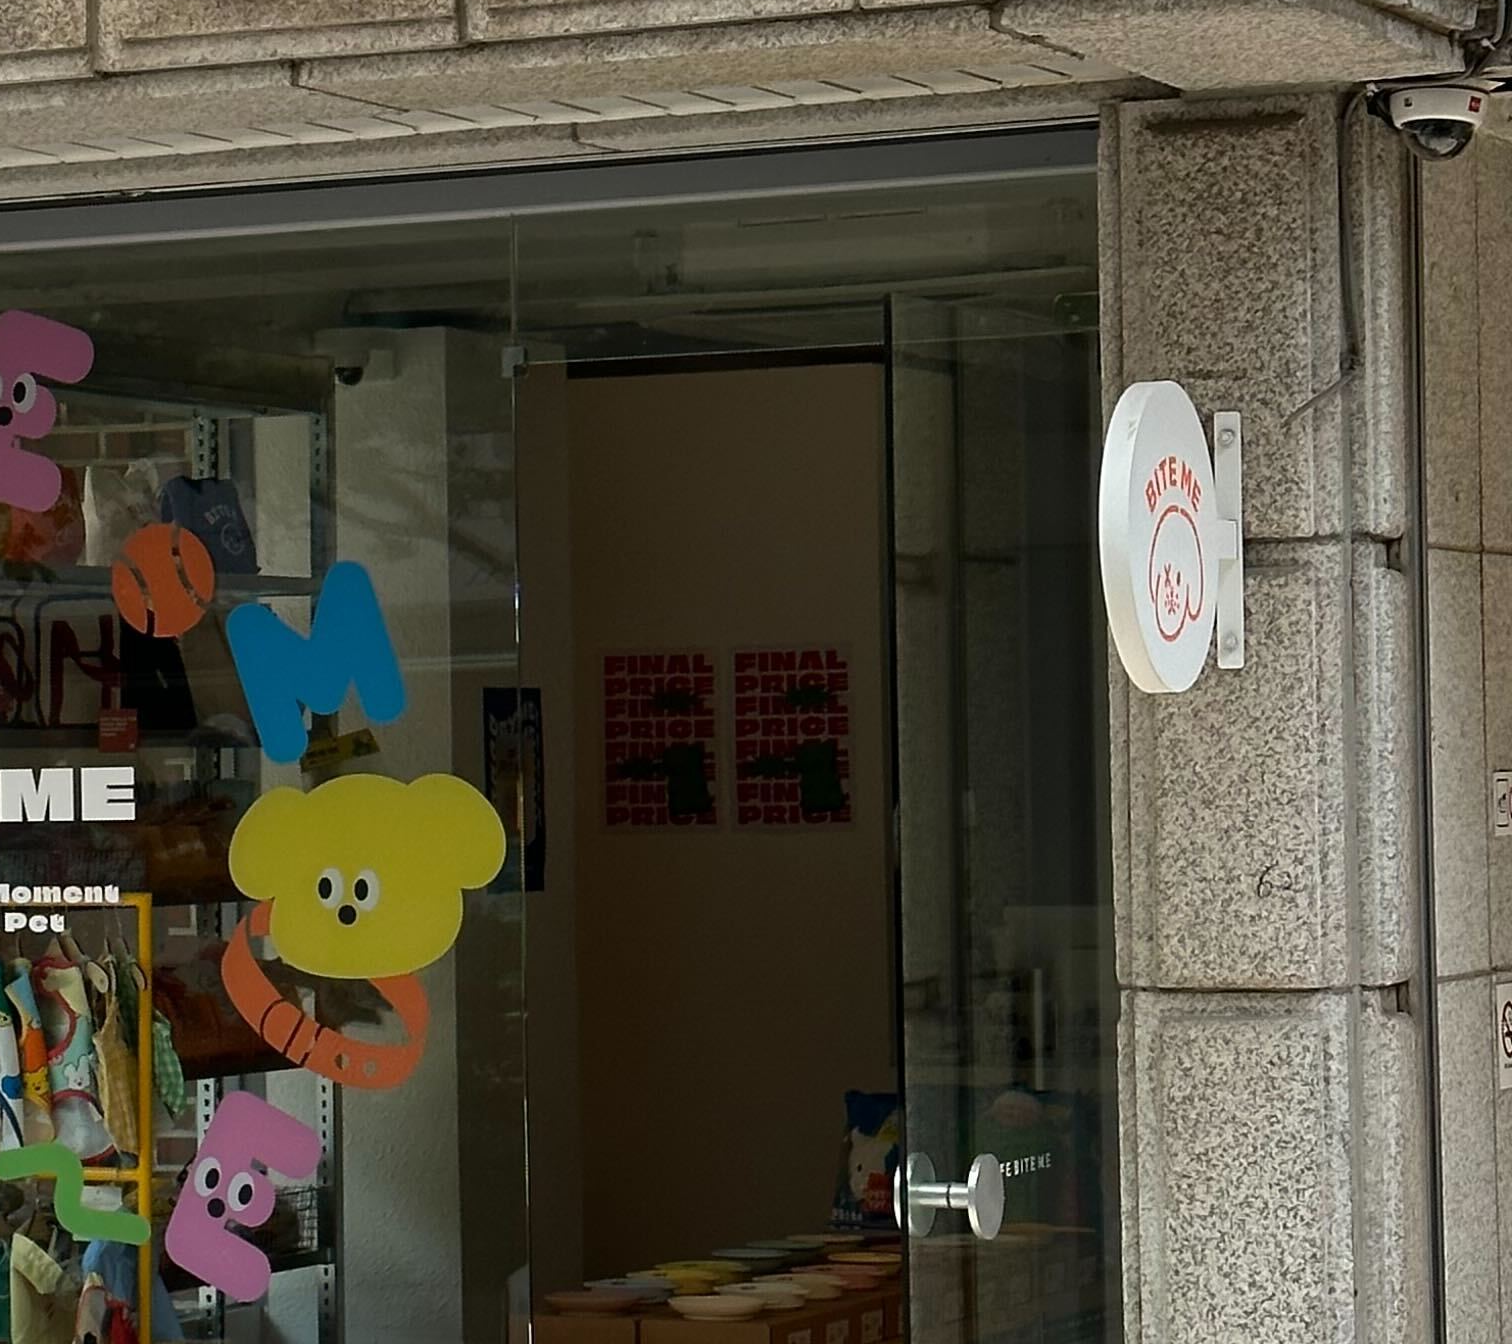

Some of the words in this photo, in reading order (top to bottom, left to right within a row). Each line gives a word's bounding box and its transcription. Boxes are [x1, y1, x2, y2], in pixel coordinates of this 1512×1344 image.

[1145, 456, 1177, 513] BITE
[1180, 461, 1202, 512] ME
[604, 654, 713, 674] FINAL
[735, 650, 847, 672] FINAL
[604, 676, 714, 696] PRICE
[735, 673, 848, 694] PRICE
[606, 719, 714, 738] PRICE
[735, 717, 849, 736] PRICE
[4, 912, 66, 934] Pet
